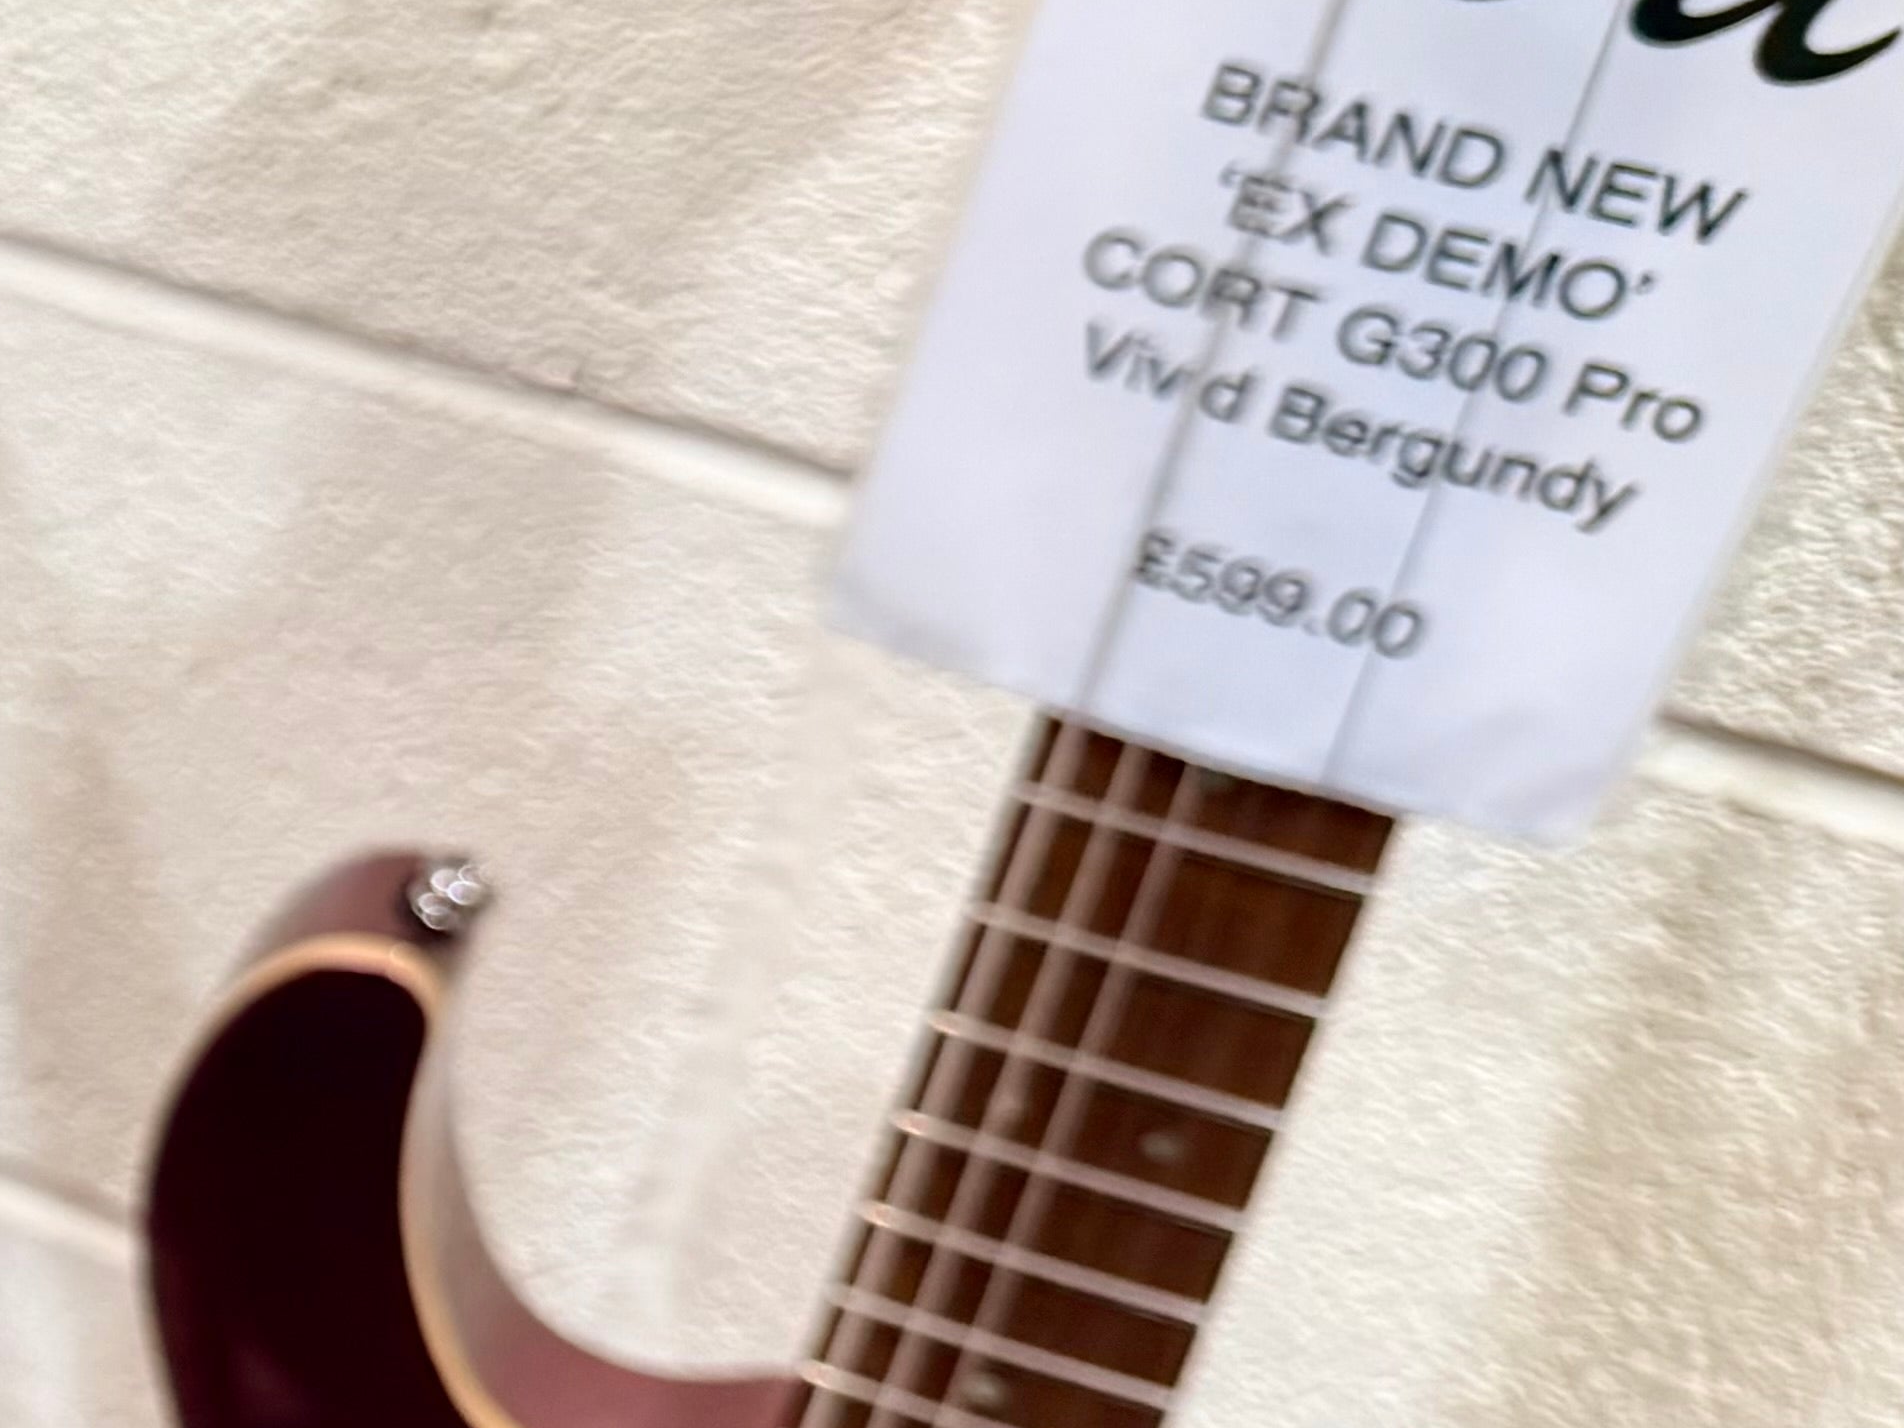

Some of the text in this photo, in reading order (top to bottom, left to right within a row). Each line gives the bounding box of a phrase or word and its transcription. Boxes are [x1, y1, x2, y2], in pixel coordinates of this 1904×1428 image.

[1199, 61, 1749, 247] BRAND NEW
[1082, 225, 1705, 444] CORT G300 Pro
[1085, 319, 1641, 535] Vivd Bergundy
[1135, 528, 1427, 661] £599.00
